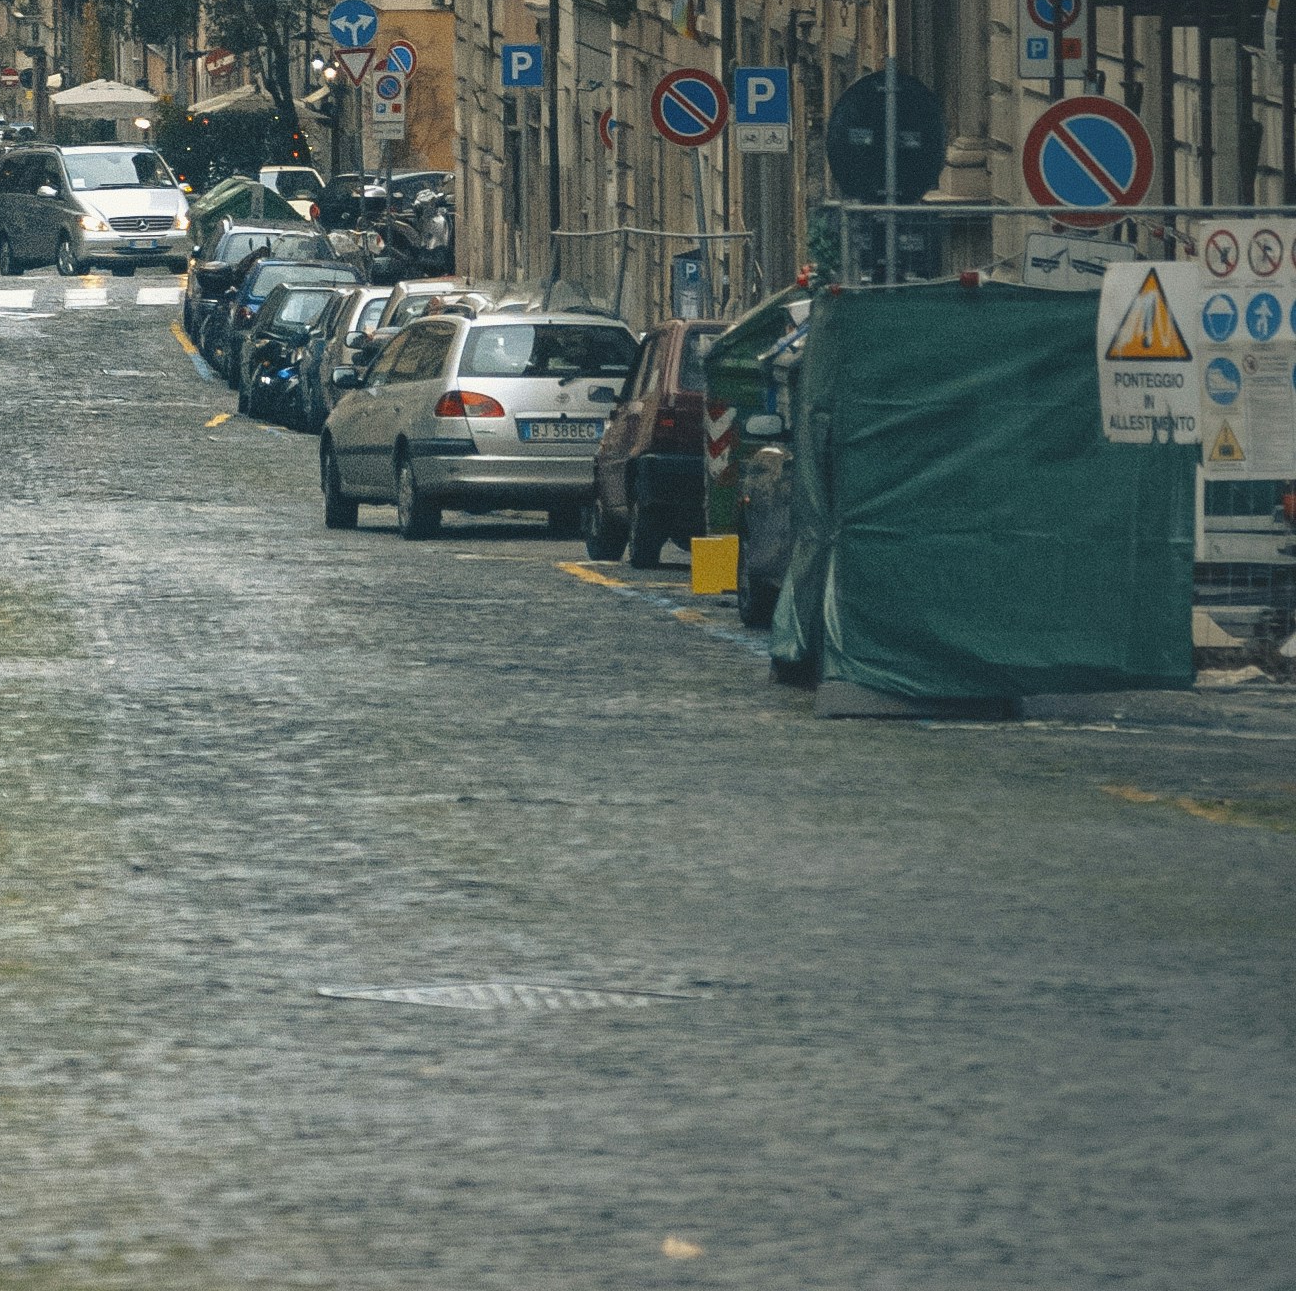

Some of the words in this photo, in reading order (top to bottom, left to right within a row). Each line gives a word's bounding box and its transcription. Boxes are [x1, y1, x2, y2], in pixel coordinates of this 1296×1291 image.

[1030, 40, 1045, 58] P
[511, 51, 533, 80] P
[747, 76, 776, 115] P
[1114, 372, 1184, 389] PONTEGGIO
